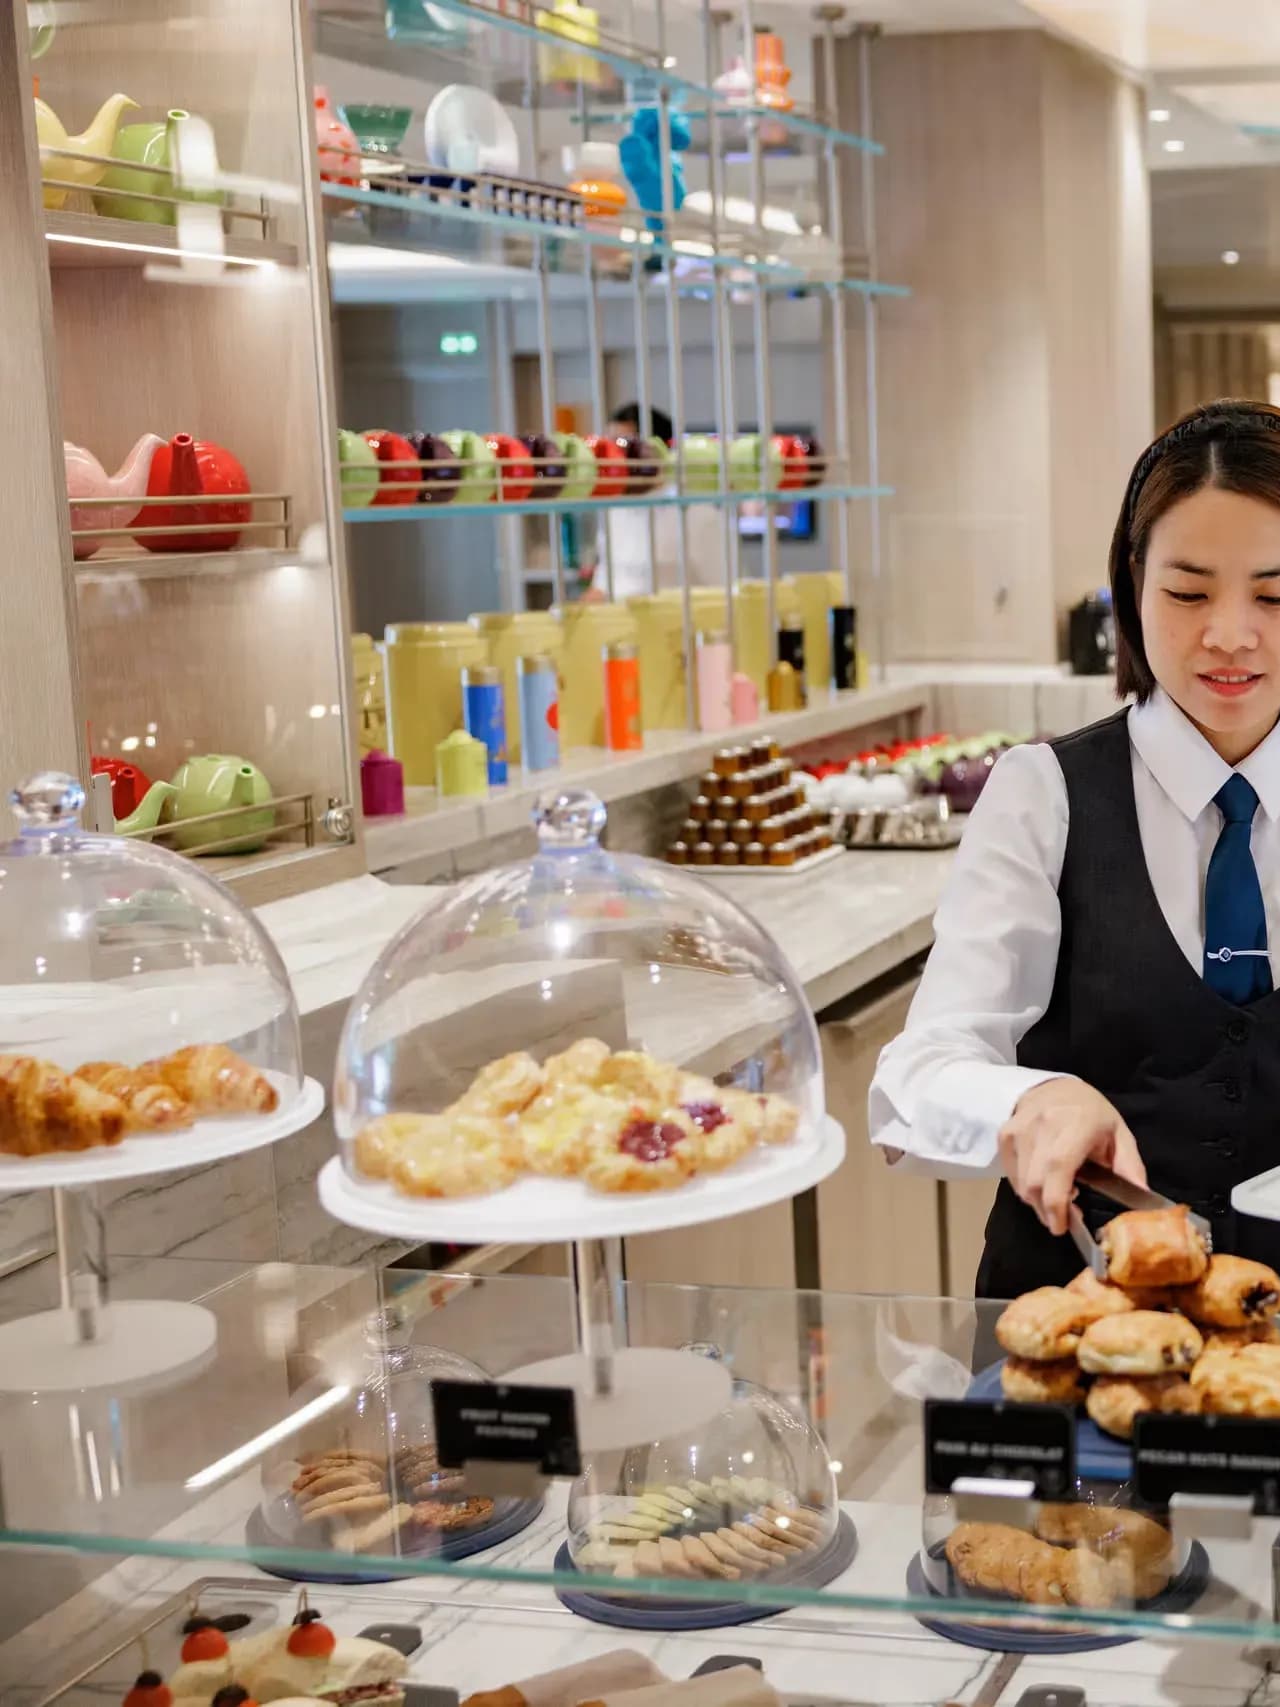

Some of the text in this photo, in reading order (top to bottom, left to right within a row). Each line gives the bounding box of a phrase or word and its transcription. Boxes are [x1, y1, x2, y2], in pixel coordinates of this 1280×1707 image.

[970, 1442, 990, 1457] AU
[991, 1443, 1064, 1461] CHOCOLAT
[1137, 1448, 1187, 1464] PECAN
[1188, 1451, 1228, 1467] NUTS
